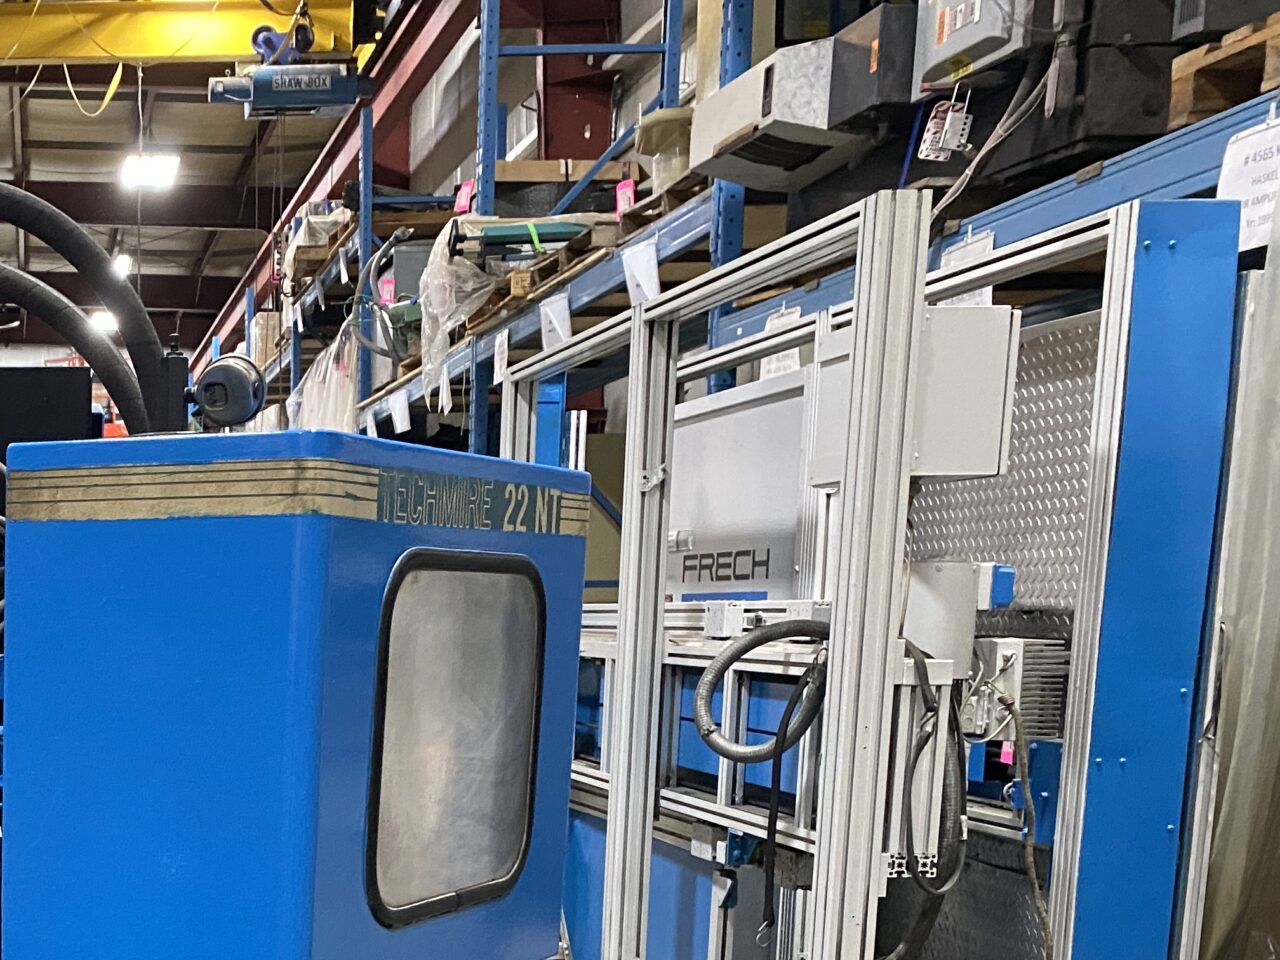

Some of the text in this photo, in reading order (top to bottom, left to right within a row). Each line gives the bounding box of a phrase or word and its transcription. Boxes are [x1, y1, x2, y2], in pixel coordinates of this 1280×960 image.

[380, 468, 561, 535] TECHMIRE 22 NT
[682, 548, 770, 583] FRECH
